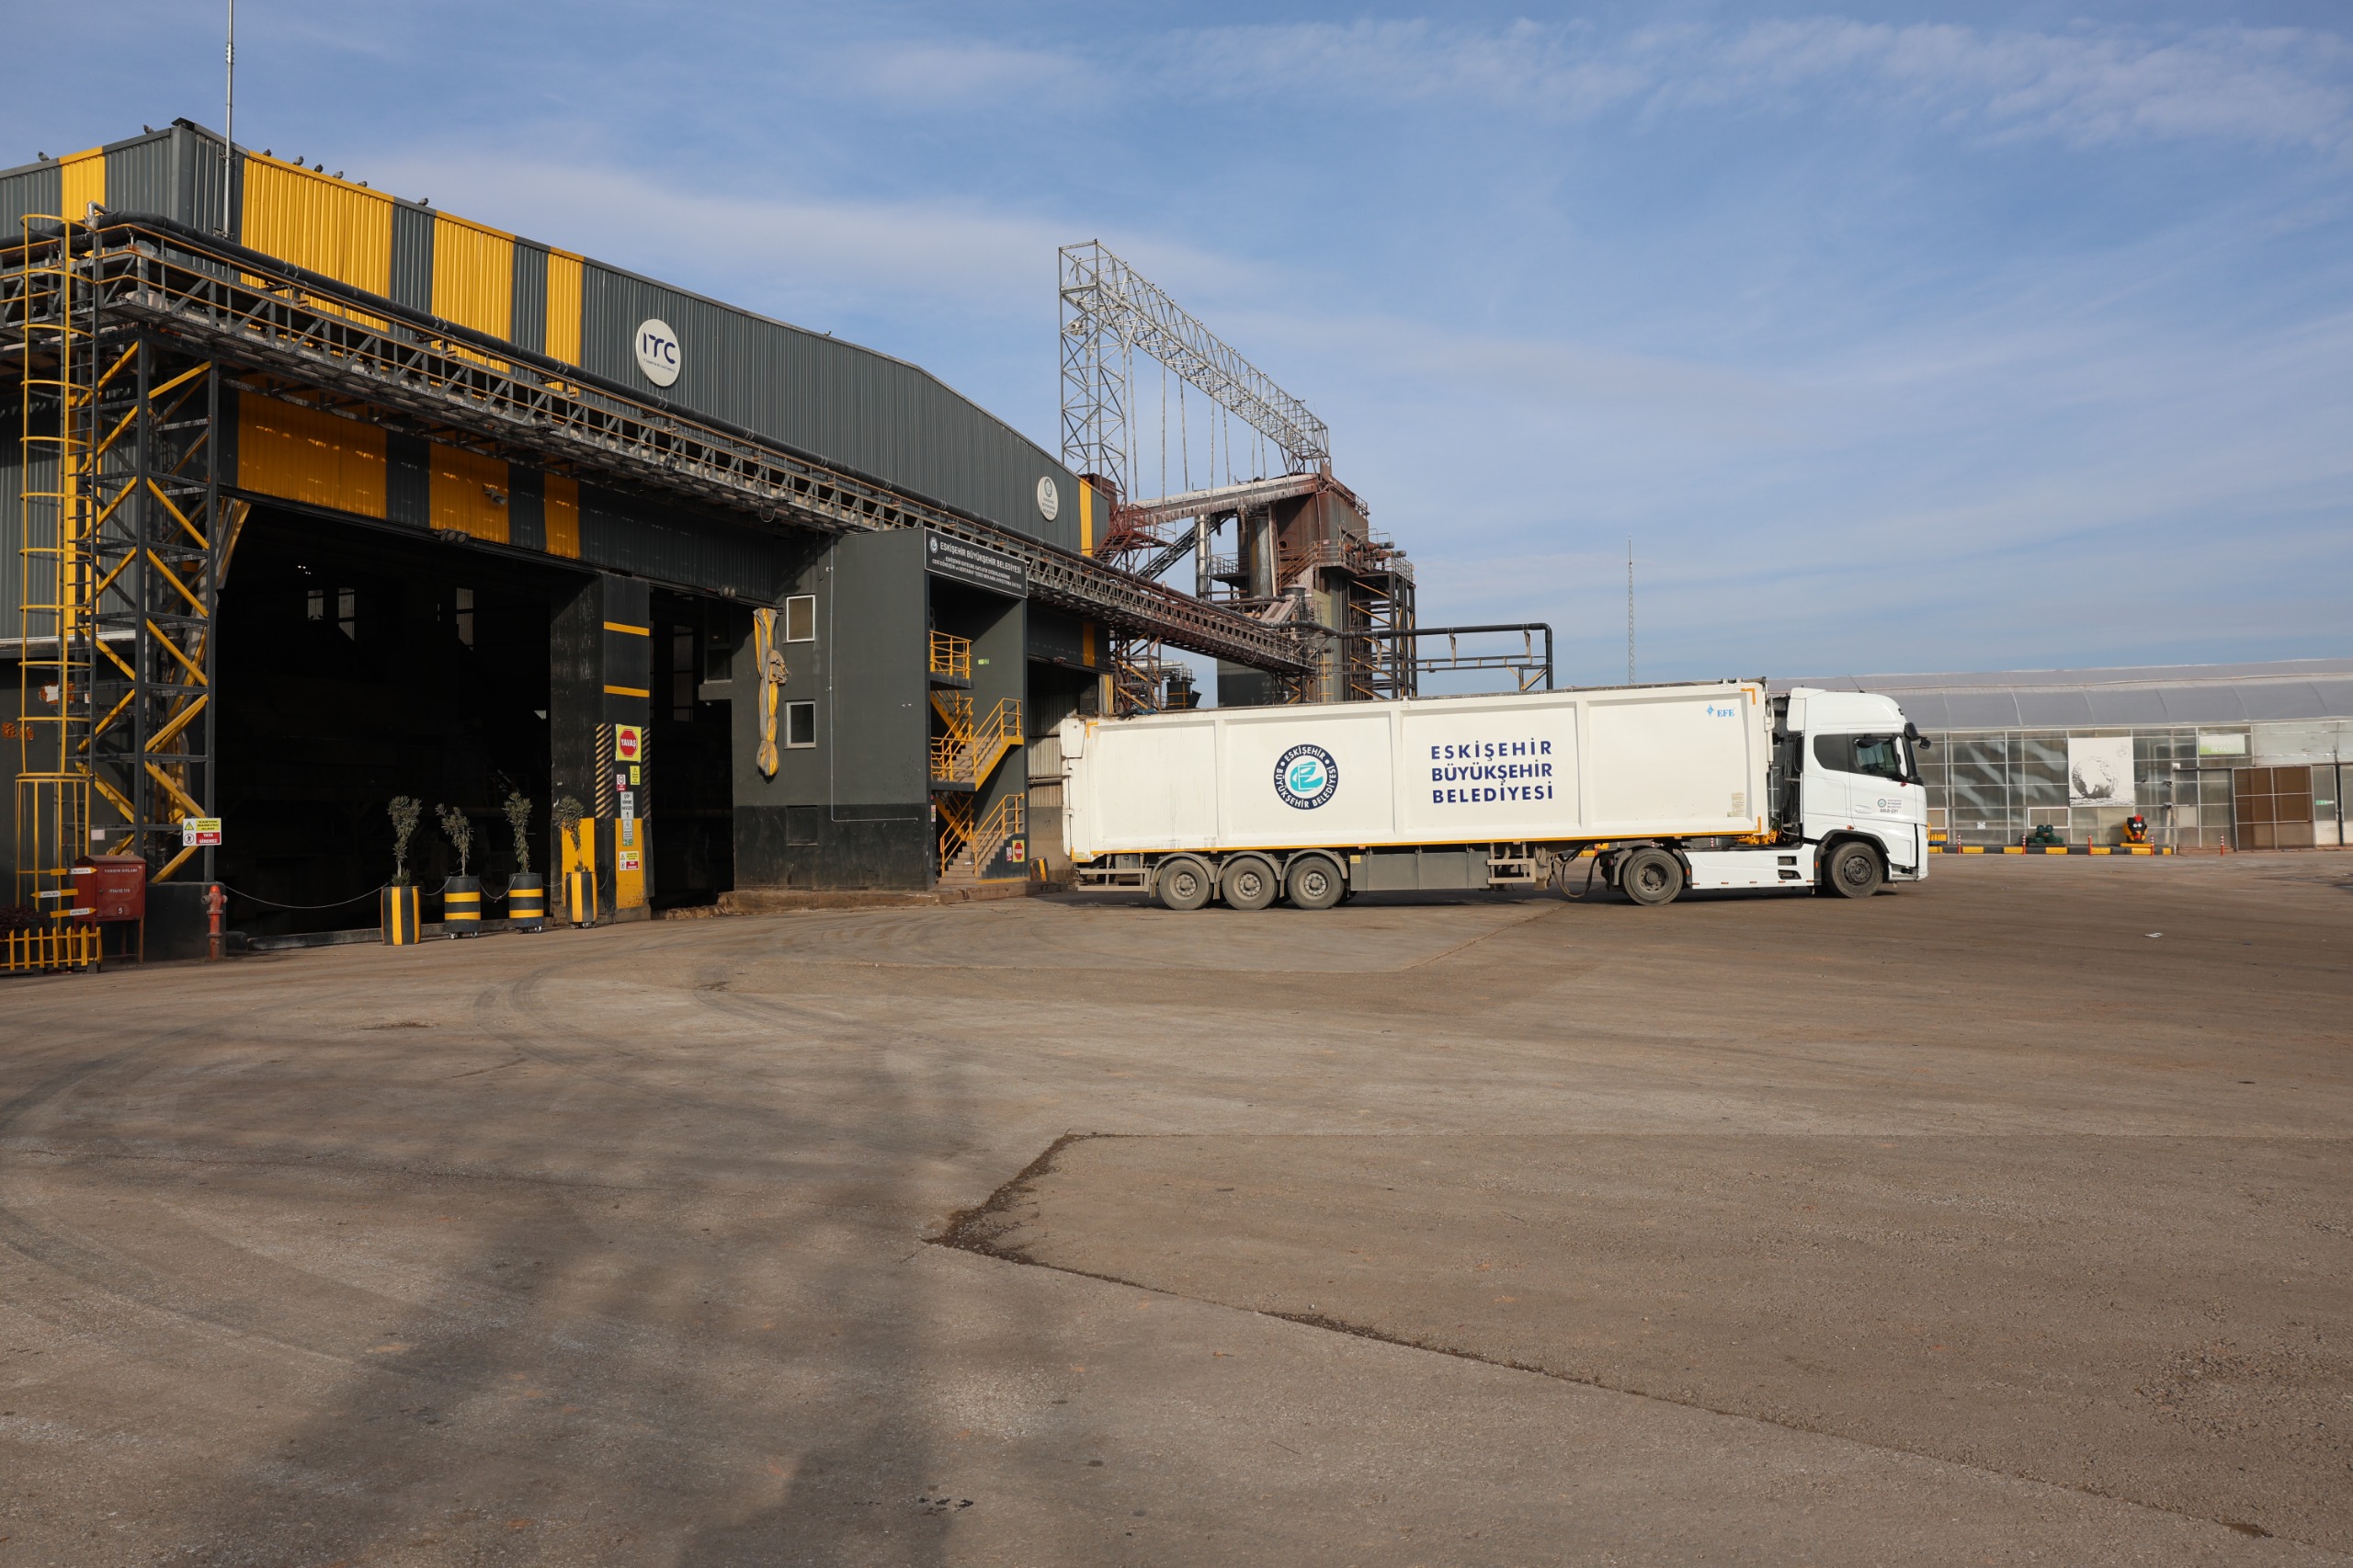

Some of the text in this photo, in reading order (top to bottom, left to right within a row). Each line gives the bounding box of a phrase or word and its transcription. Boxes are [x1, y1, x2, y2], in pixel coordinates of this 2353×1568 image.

[643, 333, 676, 364] ITC
[940, 541, 1022, 574] ESKİŞEHİR BÜYÜKŞEHİR BELEDİYESİ
[1717, 709, 1734, 717] EFE
[620, 738, 637, 749] YAVAŞ
[1283, 746, 1326, 762] ESKİŞEHİR
[1431, 737, 1552, 762] ESKİŞEHİR
[1432, 759, 1552, 783] BÜYÜKŞEHİR
[1275, 765, 1336, 808] BÜYÜKŞEHİR BELEDİYESİ
[1432, 781, 1553, 804] BELEDİYESİ
